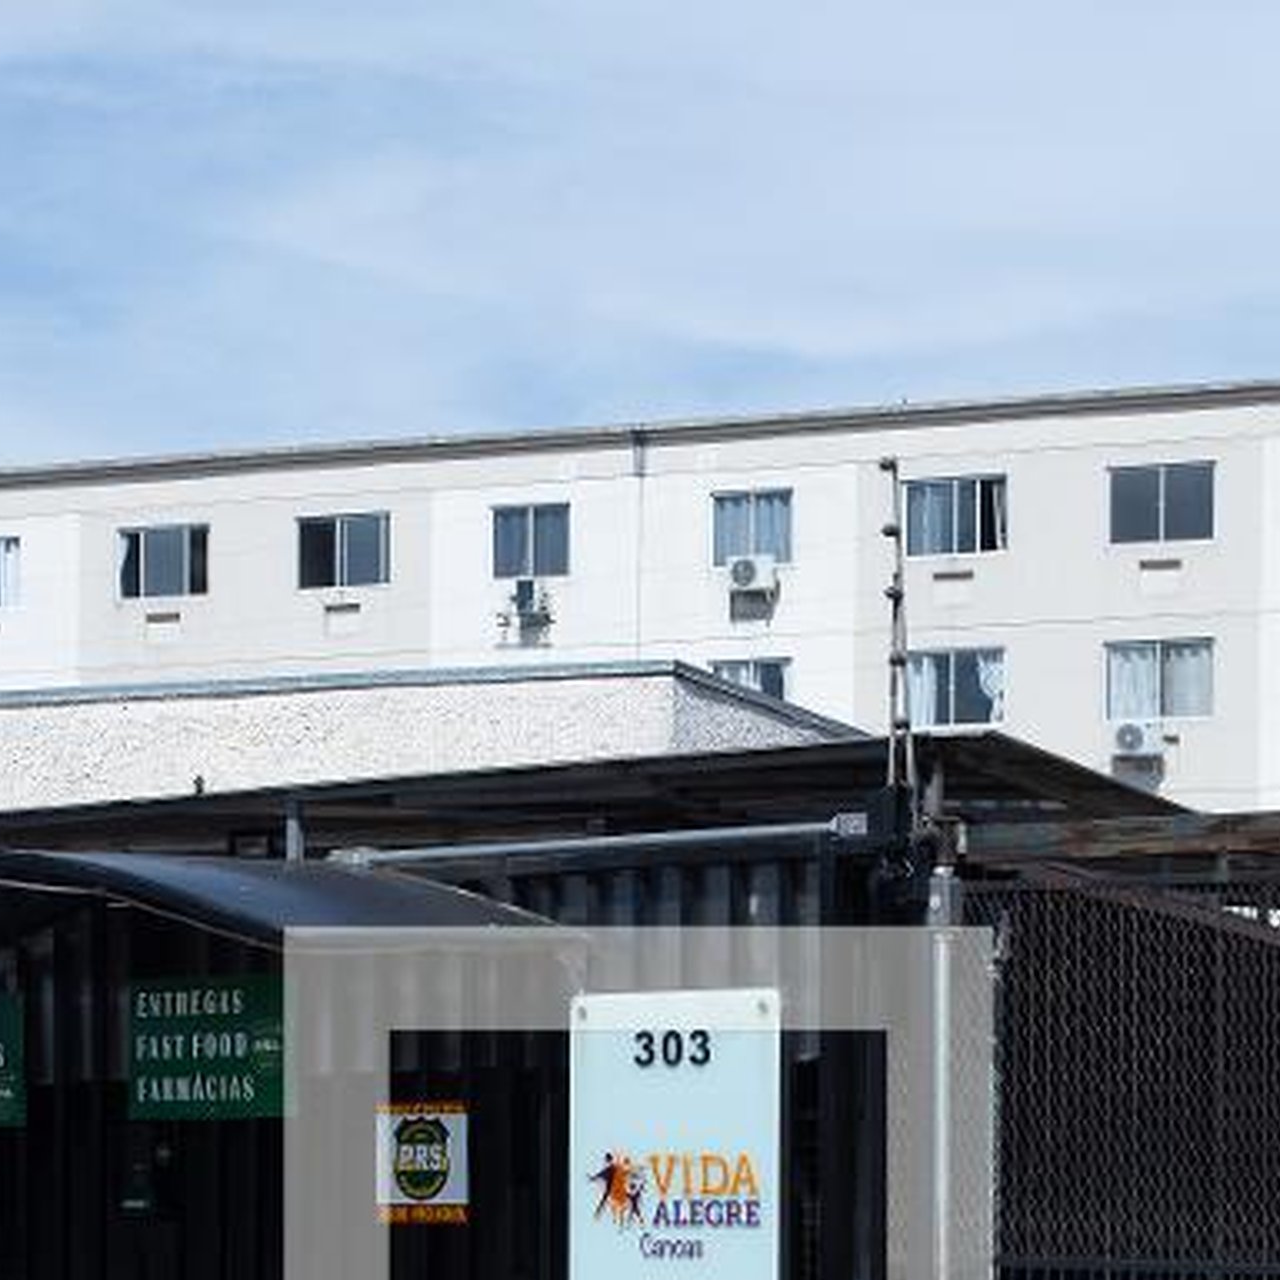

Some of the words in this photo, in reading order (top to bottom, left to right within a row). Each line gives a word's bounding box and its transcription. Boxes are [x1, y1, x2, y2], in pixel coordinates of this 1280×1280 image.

[135, 987, 246, 1018] ENTREGAS
[135, 1033, 185, 1061] FAST
[192, 1032, 249, 1060] FOOD
[633, 1029, 713, 1069] 303
[648, 1152, 759, 1196] VIDA
[652, 1199, 761, 1228] ALEGRE
[639, 1231, 705, 1259] Canoas
